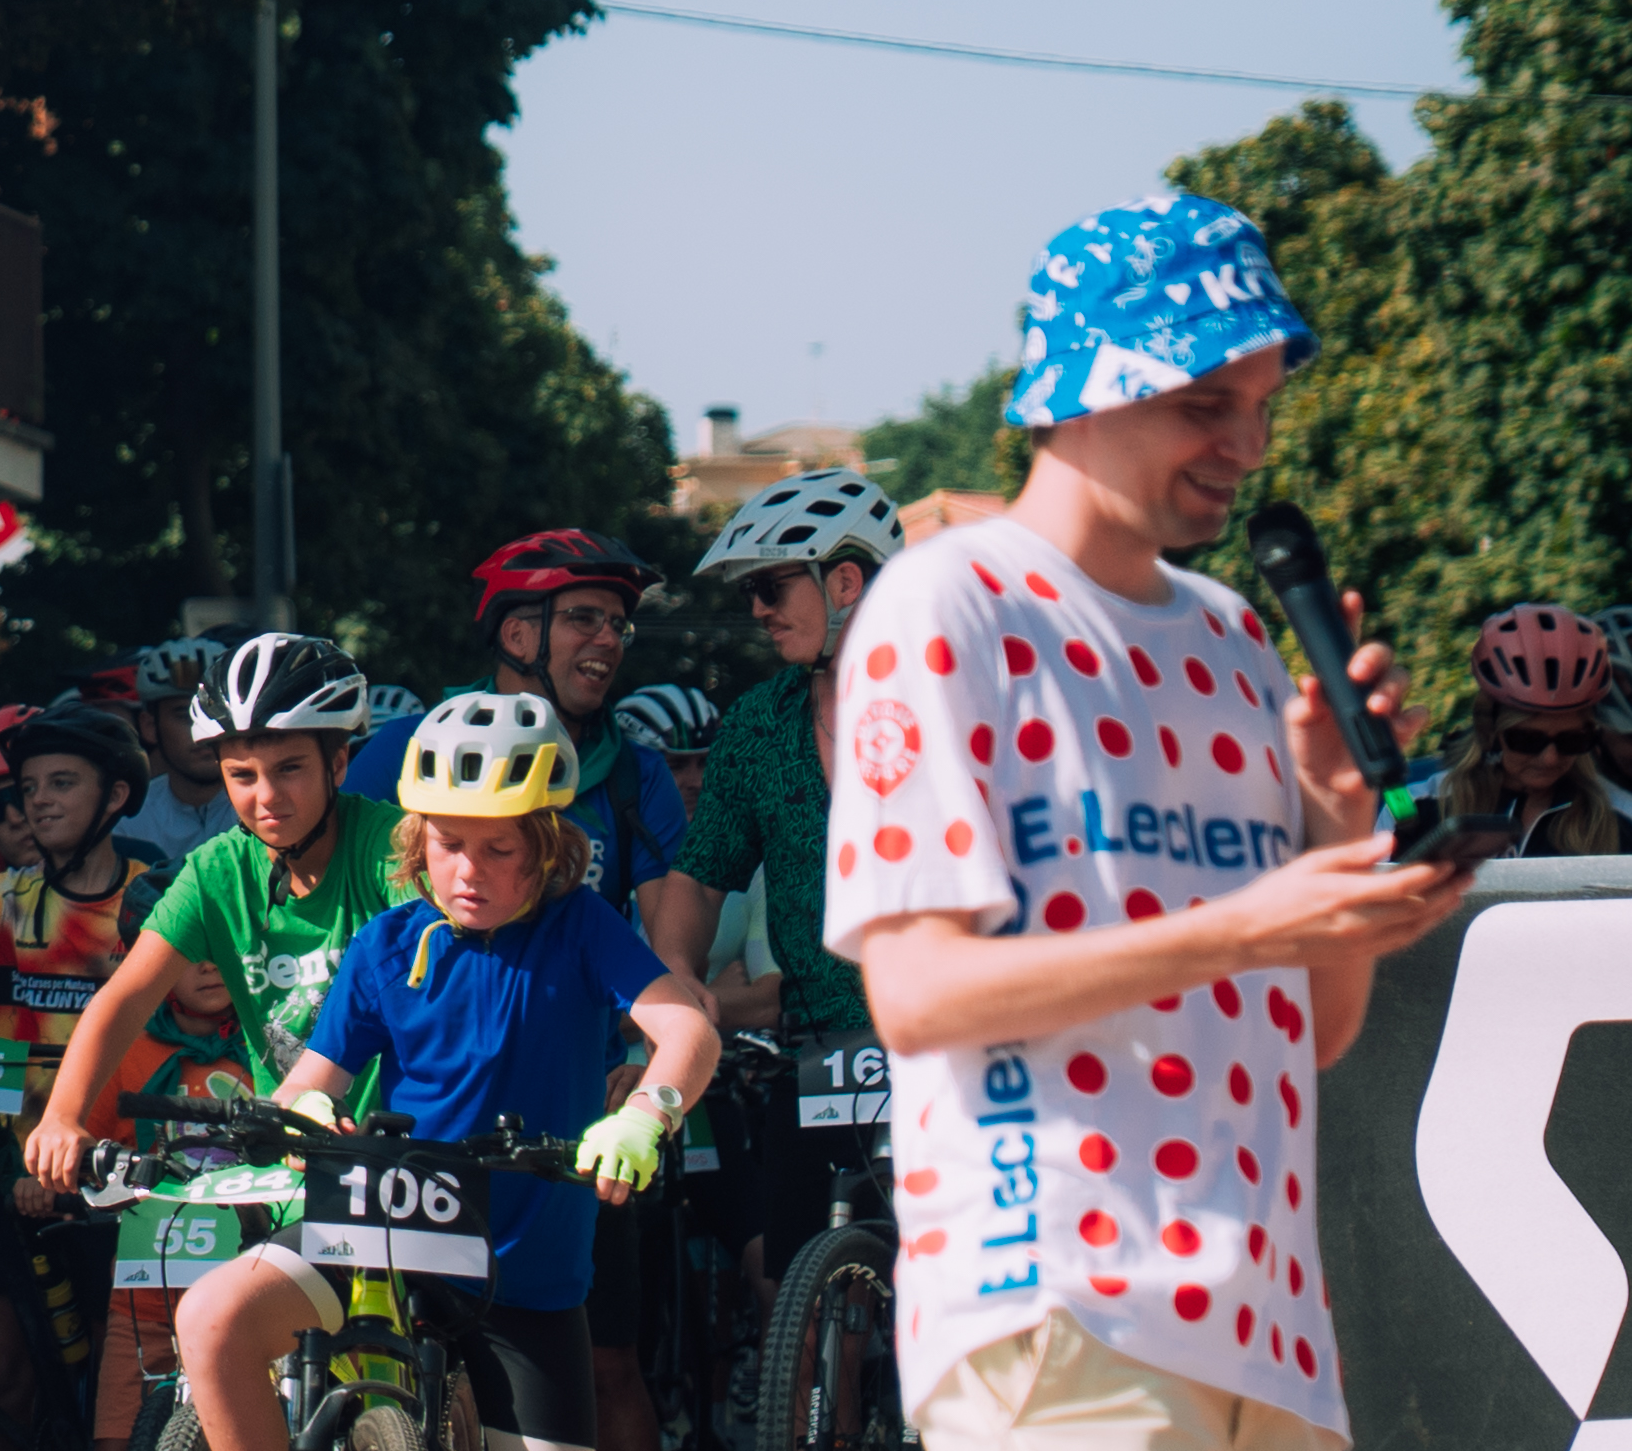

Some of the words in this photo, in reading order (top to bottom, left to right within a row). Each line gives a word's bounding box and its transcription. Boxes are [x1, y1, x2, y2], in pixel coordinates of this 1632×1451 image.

[1008, 787, 1292, 870] E.Leclerc
[823, 1046, 890, 1089] 16
[185, 1170, 292, 1199] 184
[339, 1164, 463, 1223] 106
[153, 1217, 217, 1256] 55
